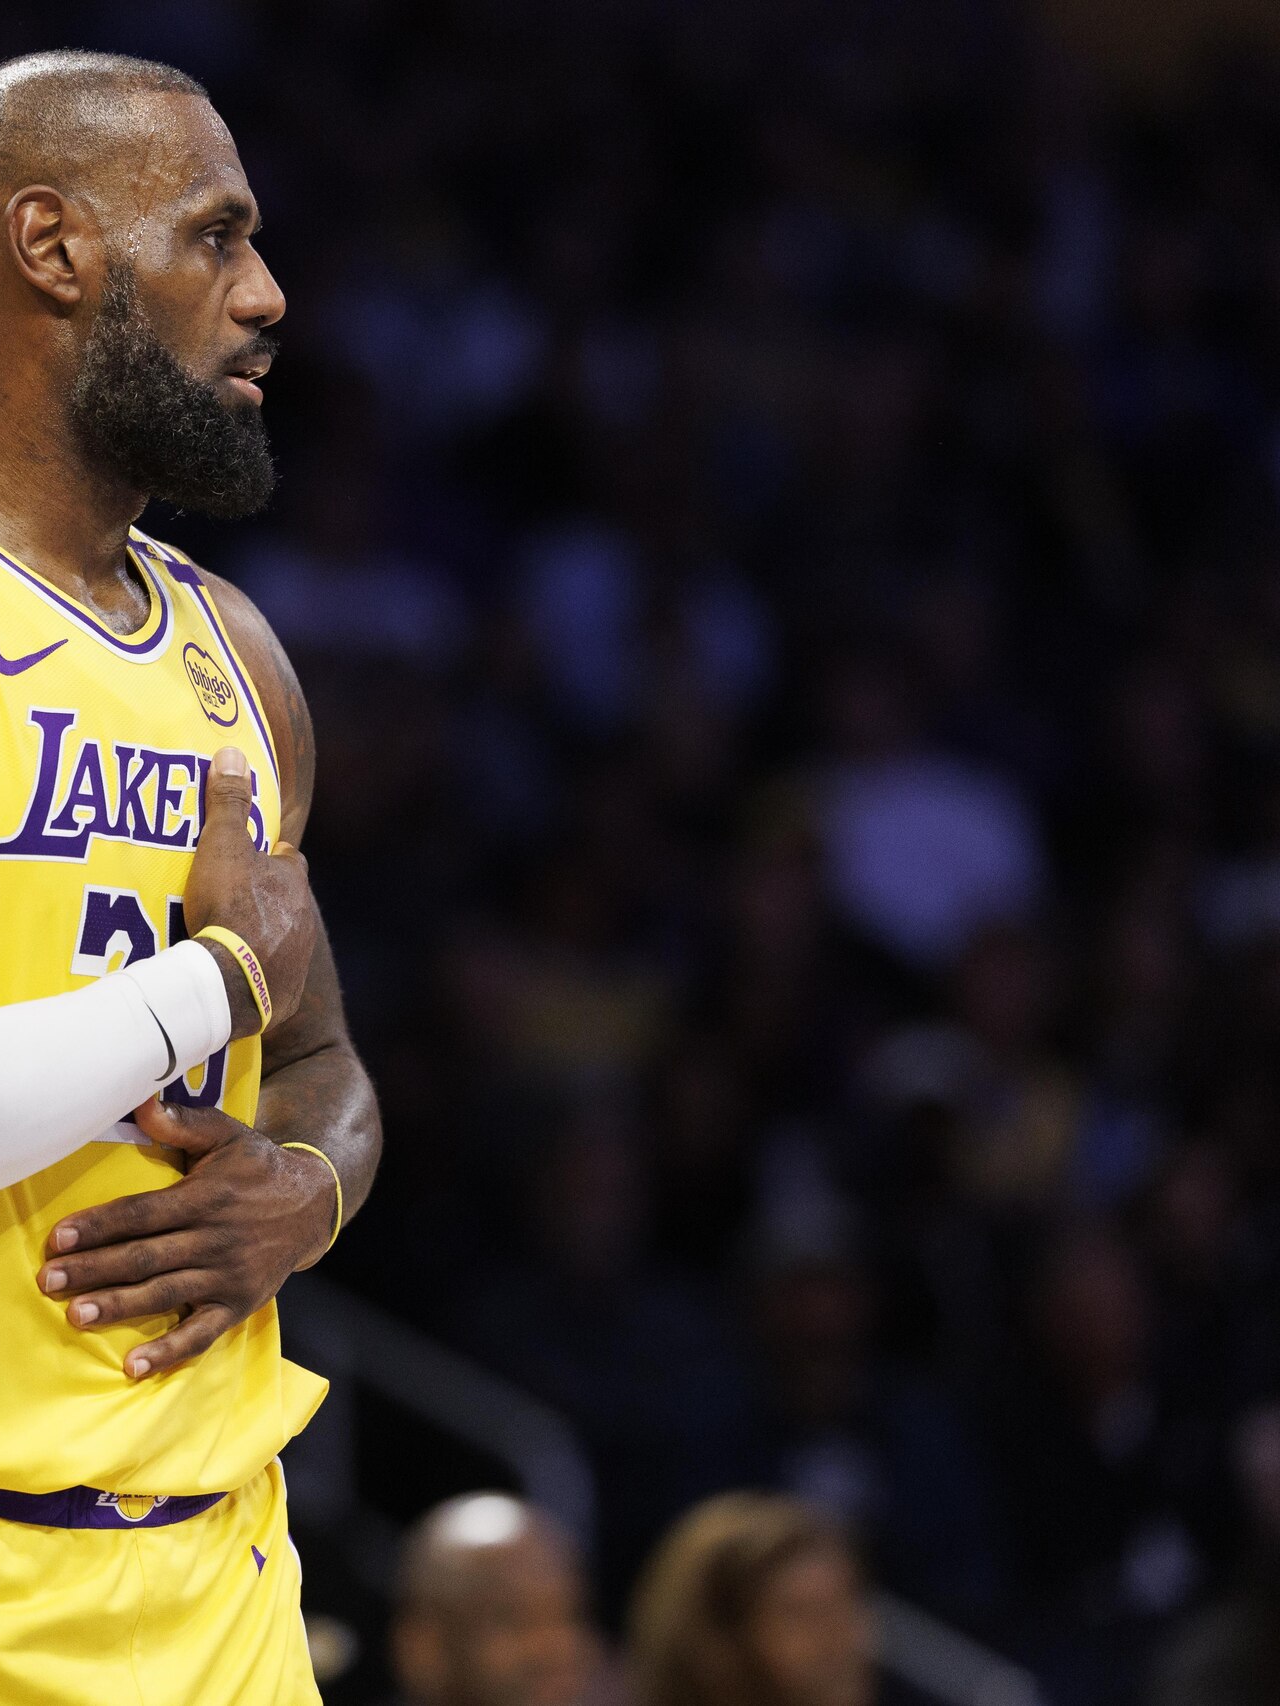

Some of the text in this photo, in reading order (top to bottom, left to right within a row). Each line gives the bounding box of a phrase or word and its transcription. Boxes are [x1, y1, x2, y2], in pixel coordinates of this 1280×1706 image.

[187, 660, 231, 705] bibigo
[237, 945, 270, 1016] I PROMISE
